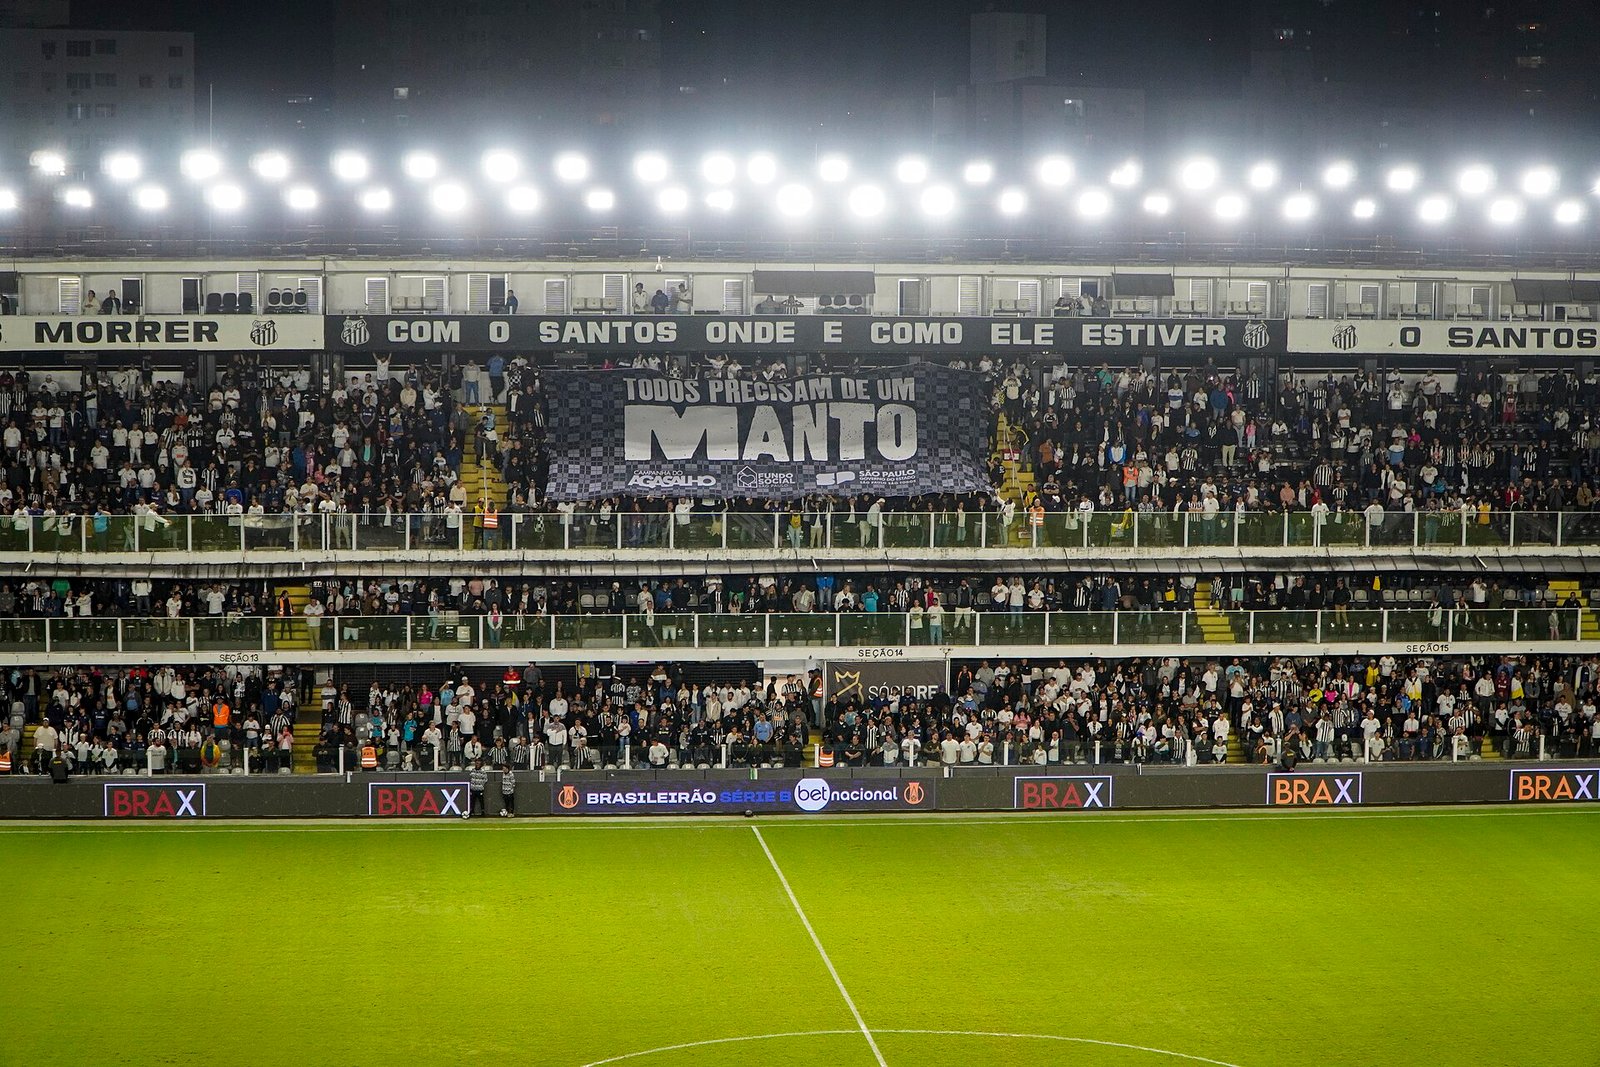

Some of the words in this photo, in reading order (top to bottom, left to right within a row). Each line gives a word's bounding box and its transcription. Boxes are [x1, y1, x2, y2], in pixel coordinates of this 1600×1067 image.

[35, 321, 219, 343] MORRER
[387, 320, 460, 343] COM
[489, 321, 510, 343] O
[539, 321, 677, 344] SANTOS
[705, 321, 795, 343] ONDE
[823, 321, 843, 343] E
[870, 322, 963, 344] COMO
[991, 323, 1054, 345] ELE
[1082, 323, 1227, 346] ESTIVER
[1400, 327, 1421, 347] O
[1448, 327, 1597, 349] SANTOS
[623, 377, 701, 403] TODOS
[708, 377, 833, 403] PRECISAM
[841, 377, 870, 400] DE
[877, 377, 916, 401] UM
[624, 402, 918, 462] MANTO
[859, 469, 881, 477] SÃO
[882, 469, 916, 478] PAULO
[586, 789, 717, 804] BRASILEIRÃO
[720, 789, 775, 803] SÉRIE
[779, 791, 793, 803] B
[1023, 782, 1104, 808] BRAX
[1275, 778, 1354, 804] BRAX
[1518, 774, 1594, 800] BRAX
[113, 790, 198, 816] BRAX
[378, 788, 462, 815] BRAX
